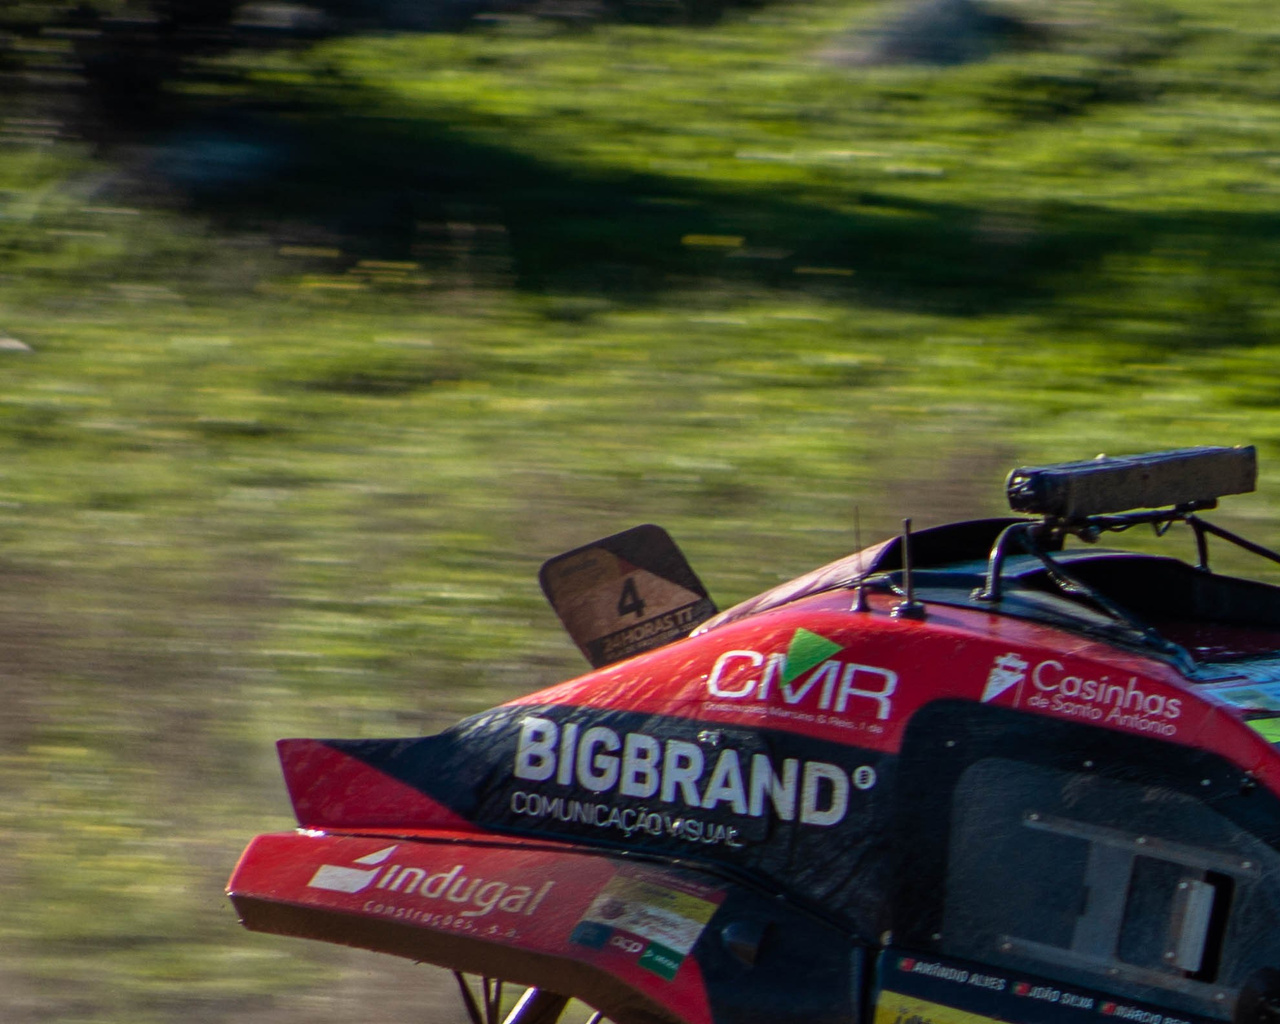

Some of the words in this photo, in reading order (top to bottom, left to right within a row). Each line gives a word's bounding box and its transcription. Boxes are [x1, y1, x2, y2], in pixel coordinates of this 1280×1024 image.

[617, 577, 646, 618] 4
[707, 650, 899, 720] CMR
[1031, 659, 1182, 719] Casinhas
[1027, 693, 1050, 709] de
[1051, 693, 1102, 720] Santo
[1104, 706, 1177, 736] António
[513, 716, 849, 827] BIGBRAND
[510, 791, 662, 838] COMUNICAÇÃO
[376, 864, 557, 918] indugal
